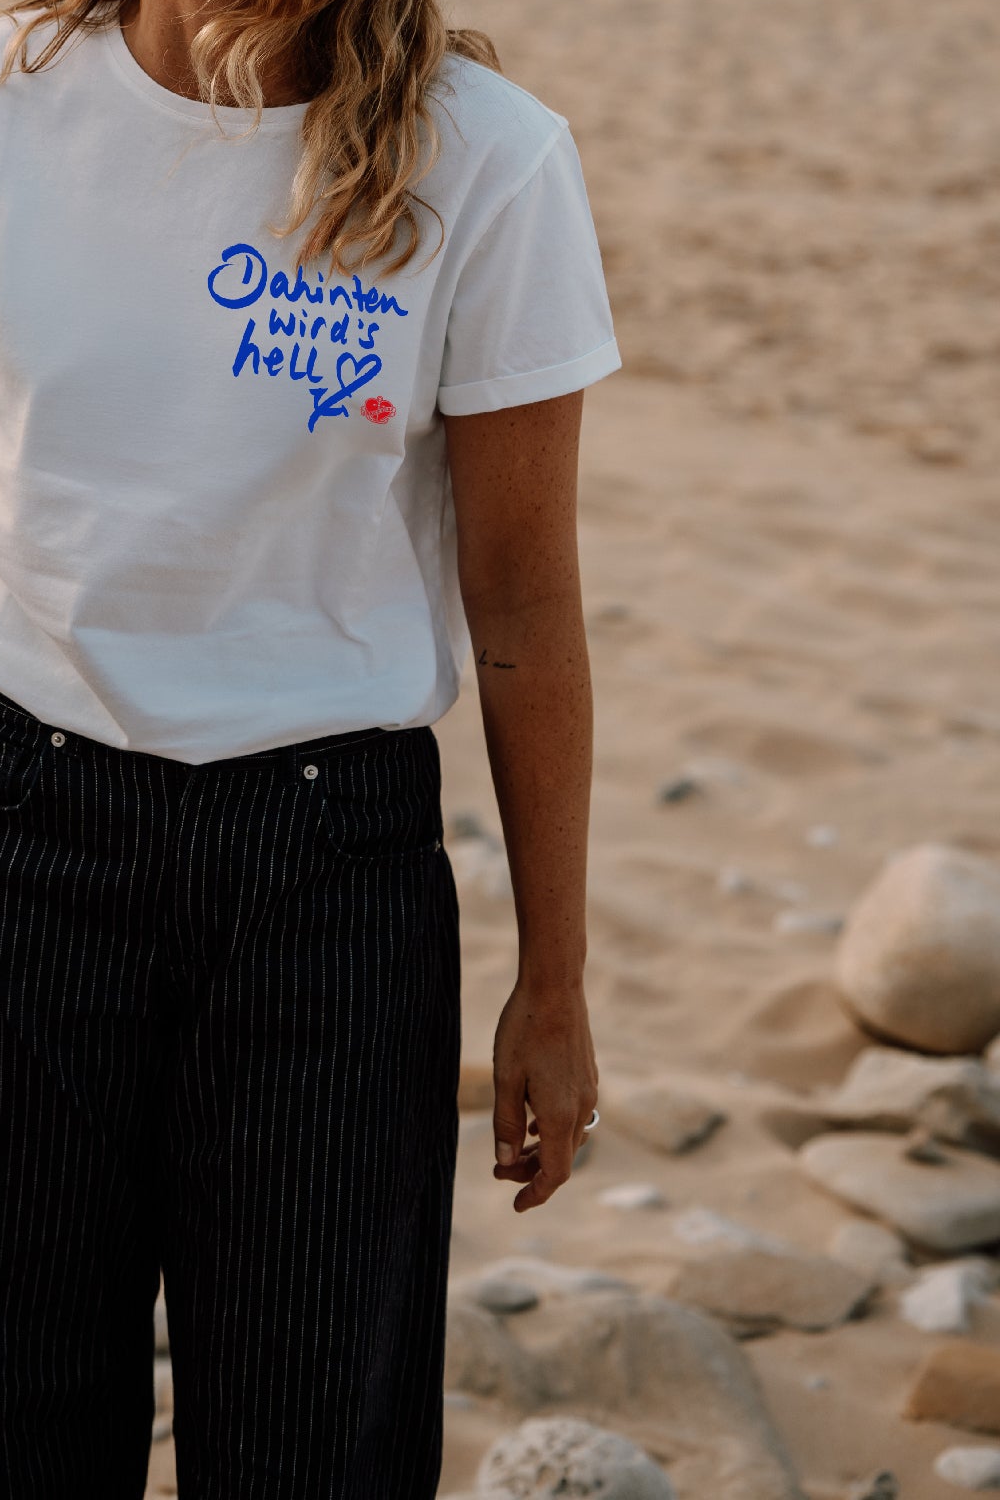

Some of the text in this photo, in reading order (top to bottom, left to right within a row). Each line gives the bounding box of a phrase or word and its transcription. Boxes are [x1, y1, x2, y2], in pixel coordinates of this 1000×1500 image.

[208, 243, 409, 317] Dahinten
[232, 318, 323, 383] hell
[269, 308, 380, 350] wird's
